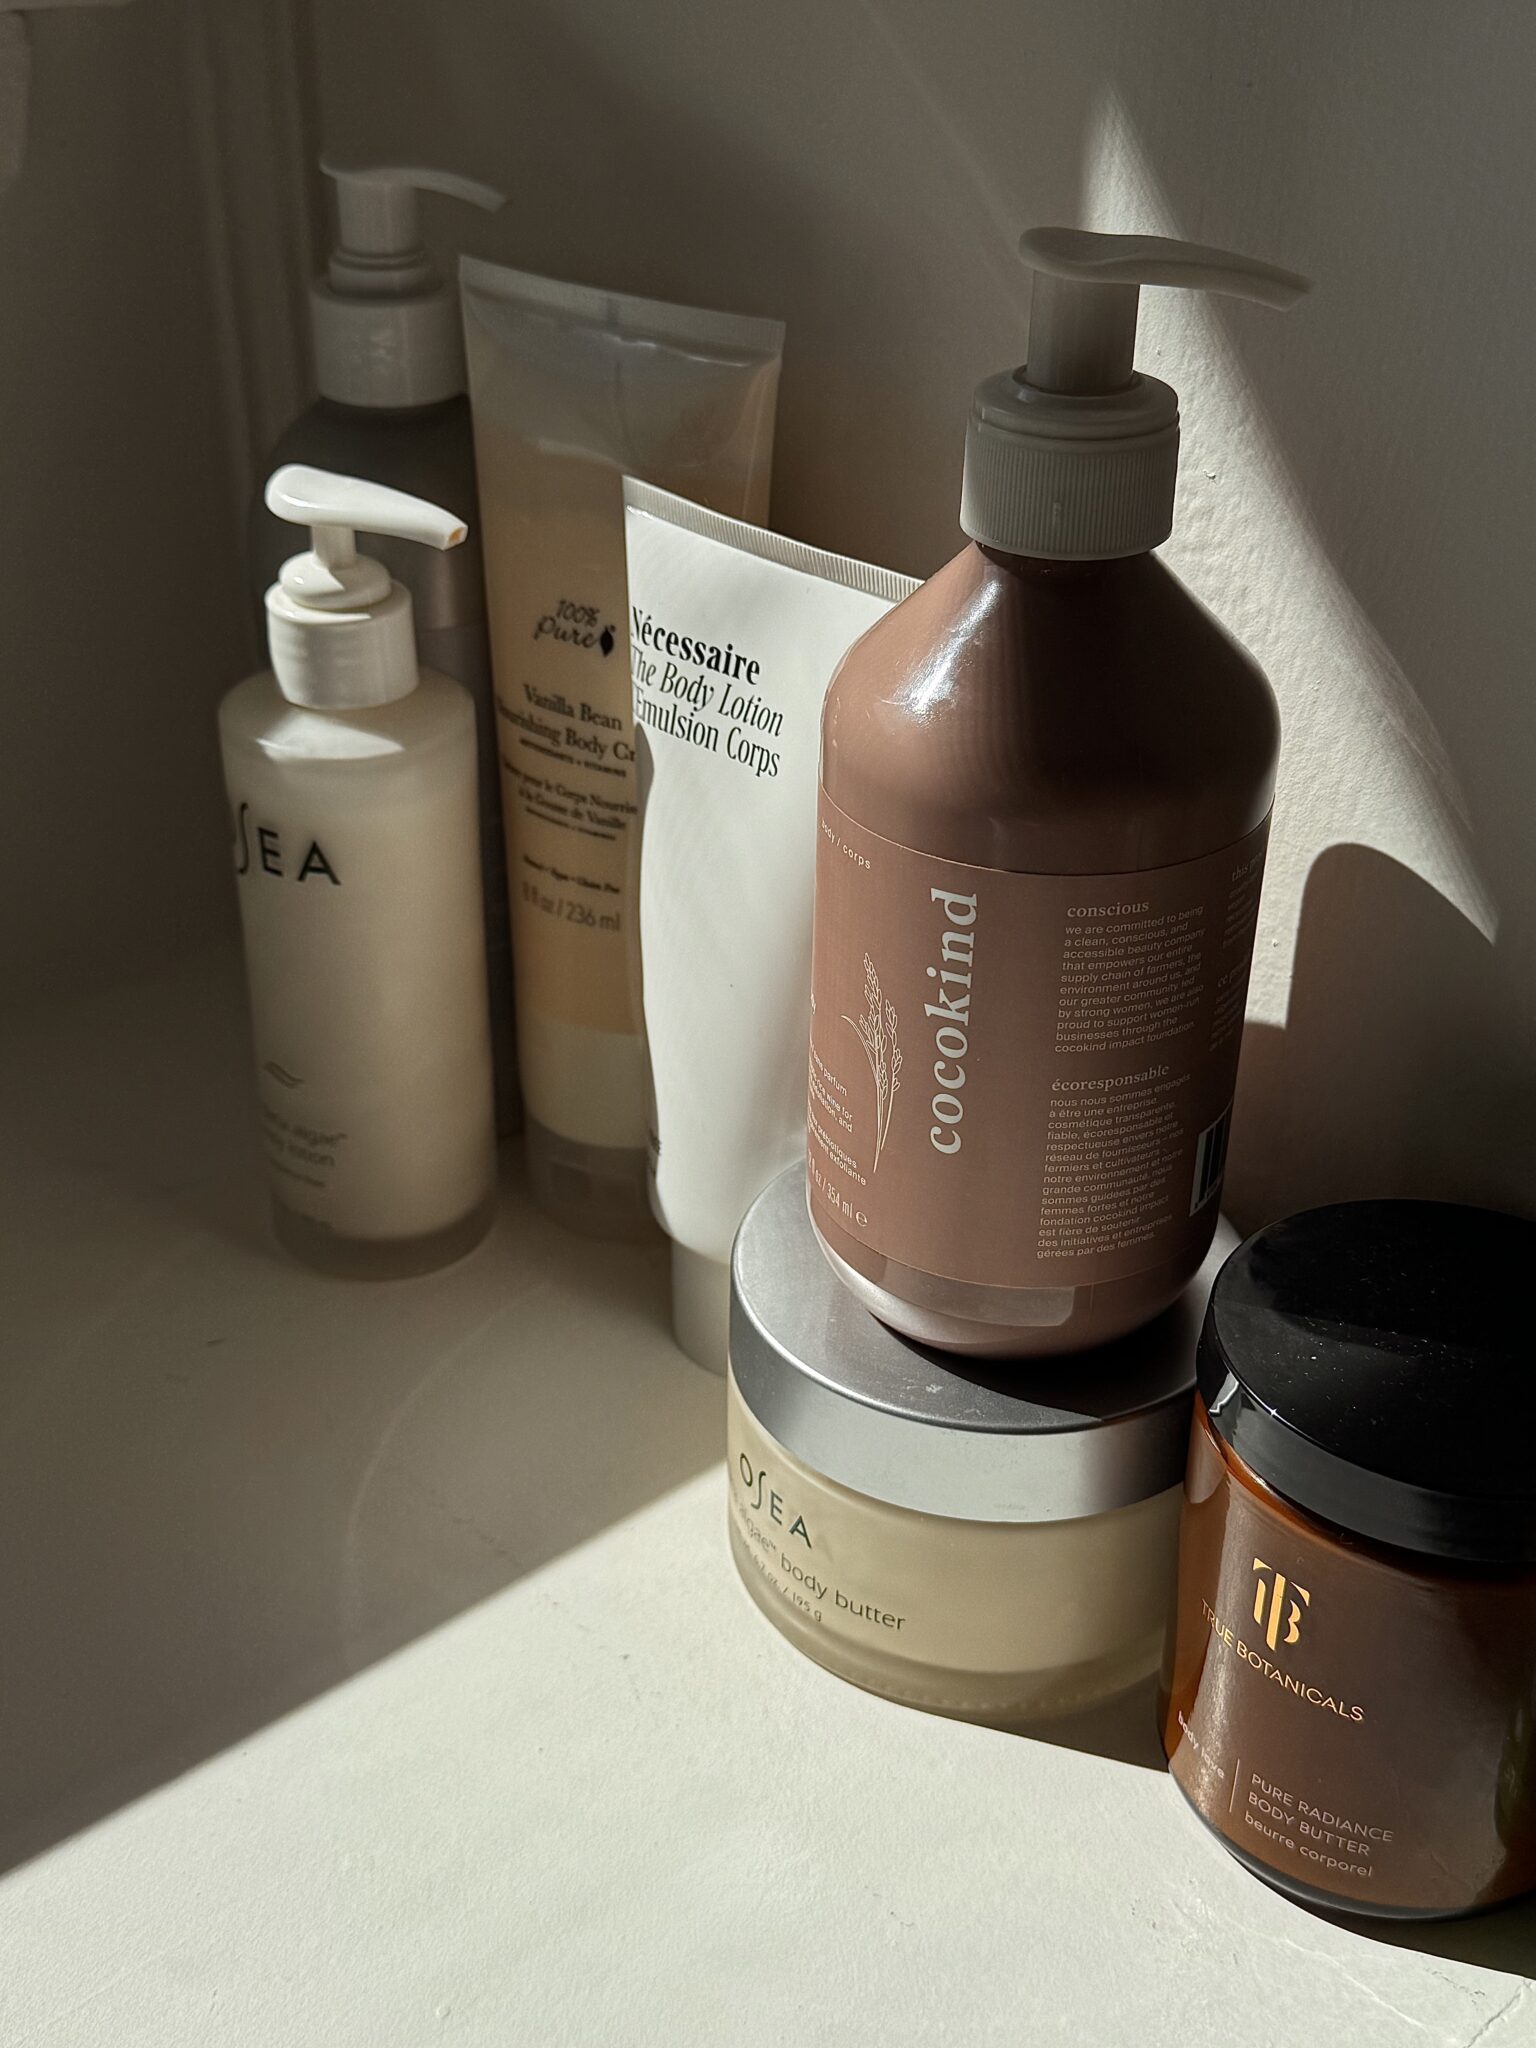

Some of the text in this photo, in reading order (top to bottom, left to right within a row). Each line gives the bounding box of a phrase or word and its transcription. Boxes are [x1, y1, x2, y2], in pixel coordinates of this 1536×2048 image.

[556, 600, 600, 627] 100%
[631, 605, 760, 685] Nécessaire
[631, 645, 784, 737] The Body Lotion
[580, 703, 622, 731] Bean
[632, 681, 781, 778] Emulsion Corps
[566, 728, 608, 760] Body
[237, 802, 342, 886] SEA
[842, 844, 871, 870] corps
[599, 912, 620, 932] ml
[1067, 902, 1150, 917] conscious
[1064, 921, 1189, 947] a clean, conscious, and
[1065, 926, 1081, 934] we
[1085, 925, 1104, 934] are
[1105, 916, 1164, 934] committed
[1167, 914, 1176, 924] to
[1062, 944, 1193, 970] that empowers our entire
[1063, 928, 1206, 958] accessible beauty company
[1060, 973, 1098, 984] supply
[1101, 969, 1131, 980] chain
[1133, 966, 1144, 977] of
[1187, 952, 1201, 963] the
[1060, 982, 1130, 994] environment
[1132, 973, 1167, 988] around
[1184, 963, 1200, 976] and
[1058, 1009, 1071, 1019] by
[1074, 1006, 1110, 1018] strong
[1155, 997, 1169, 1007] we
[1170, 991, 1185, 1002] are
[1059, 998, 1078, 1007] our
[1081, 994, 1121, 1008] greater
[1181, 975, 1195, 988] led
[924, 888, 978, 1155] cocokind
[1056, 1016, 1178, 1041] businesses through the
[1057, 1019, 1090, 1030] proud
[1093, 1018, 1104, 1028] to
[1107, 1013, 1148, 1027] support
[1055, 1041, 1107, 1052] cocokind
[1109, 1036, 1145, 1049] impact
[823, 1068, 847, 1097] parfum
[1052, 1064, 1170, 1091] écoresponsable
[1050, 1099, 1077, 1107] nous
[1080, 1096, 1107, 1106] nous
[1109, 1087, 1152, 1103] sommes
[1059, 1107, 1081, 1118] être
[1084, 1106, 1104, 1117] une
[1107, 1097, 1157, 1114] entreprise
[838, 1116, 852, 1133] and
[842, 1106, 853, 1120] for
[1047, 1112, 1173, 1140] fiable, écoresponsable et
[1048, 1117, 1112, 1129] cosmétique
[1045, 1128, 1184, 1162] réseau de fournisseurs nos
[1046, 1121, 1178, 1152] respectueuse envers notre
[829, 1151, 866, 1186] exfoliante
[1043, 1174, 1073, 1184] notre
[1075, 1161, 1149, 1183] environnement
[1151, 1157, 1160, 1168] et
[1044, 1148, 1160, 1173] fermiers et cultivateurs
[827, 1182, 840, 1207] 354
[841, 1201, 853, 1219] ml
[1040, 1191, 1155, 1216] femmes fortes et notre
[1041, 1176, 1166, 1205] sommes guidées par des
[1042, 1184, 1081, 1196] grande
[1039, 1194, 1169, 1226] fondation cocokind impact
[1037, 1237, 1058, 1247] des
[1060, 1233, 1110, 1247] initiatives
[1112, 1230, 1122, 1240] et
[1038, 1216, 1142, 1237] est fière de soutenir
[1036, 1248, 1075, 1260] gérées
[1077, 1246, 1095, 1257] par
[1096, 1242, 1116, 1253] des
[739, 1452, 812, 1549] OSEA
[781, 1553, 828, 1600] body
[835, 1590, 906, 1631] butter
[814, 1610, 823, 1623] g
[1201, 1598, 1365, 1722] TRUE BOTANICALS
[1178, 1710, 1199, 1750] body
[1251, 1773, 1394, 1843] PURE RADIANCE
[1248, 1791, 1370, 1856] BODY BUTTER
[1244, 1810, 1373, 1878] beurre corporel
